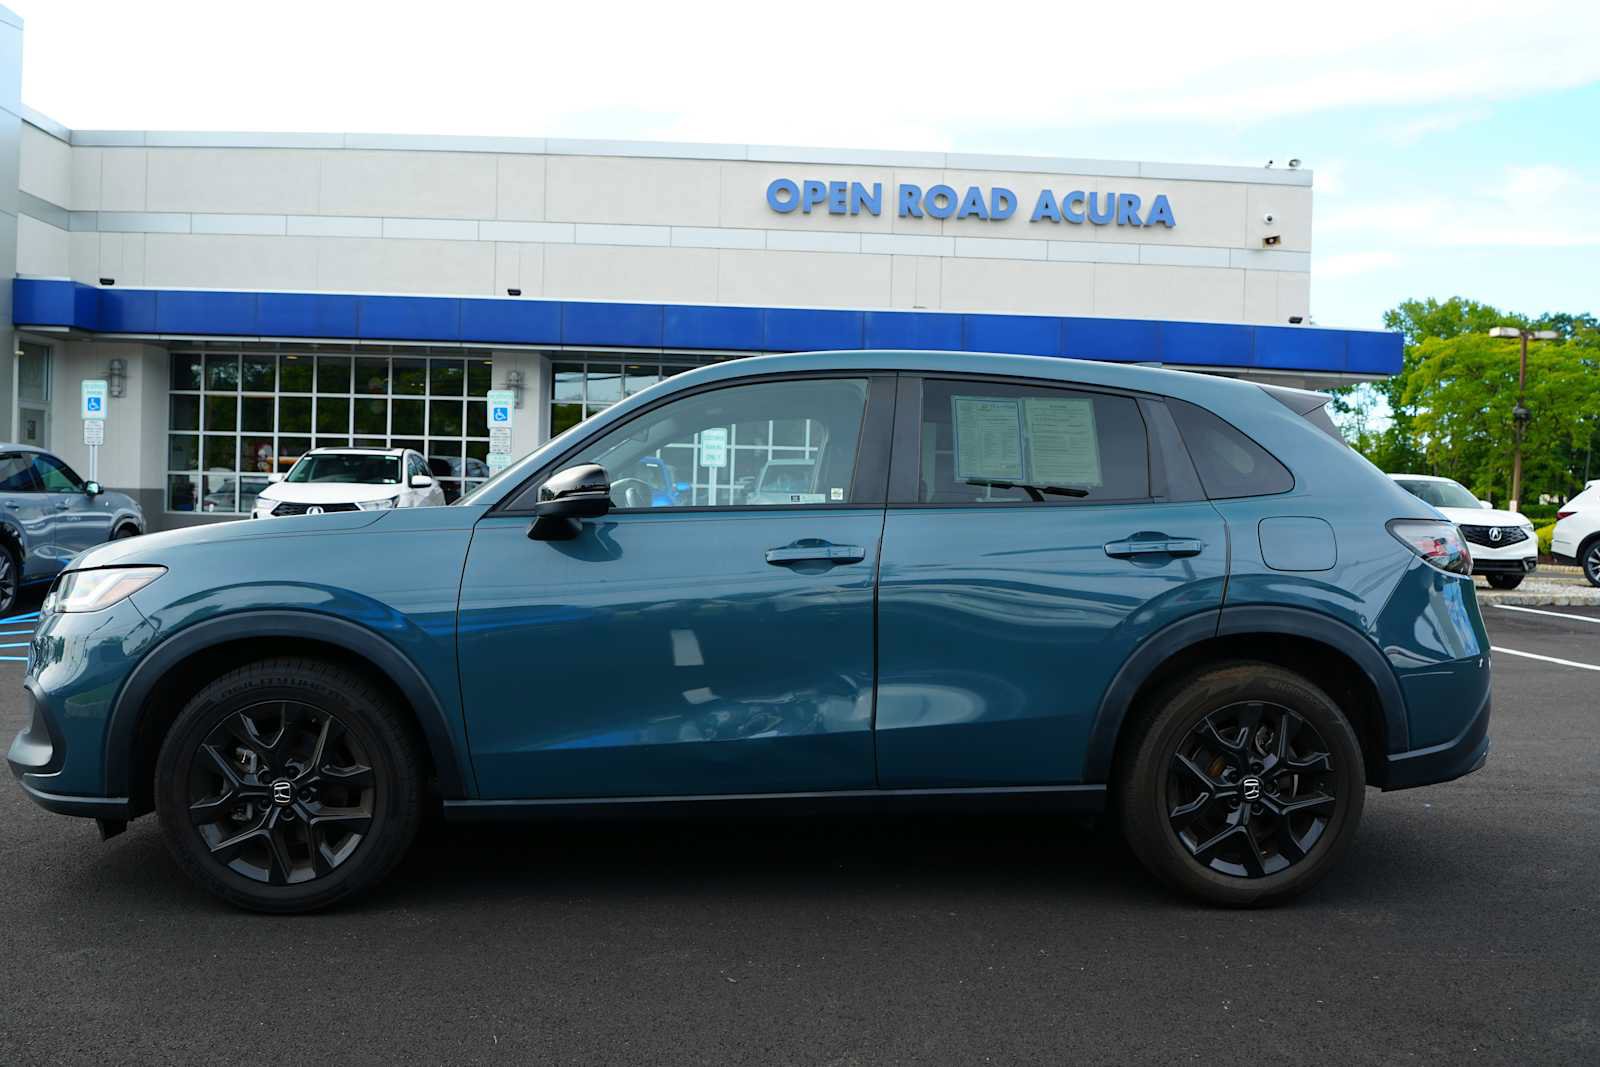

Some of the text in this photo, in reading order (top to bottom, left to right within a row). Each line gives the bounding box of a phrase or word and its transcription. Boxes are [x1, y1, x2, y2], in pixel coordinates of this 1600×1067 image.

[766, 178, 1177, 228] OPEN ROAD ACURA
